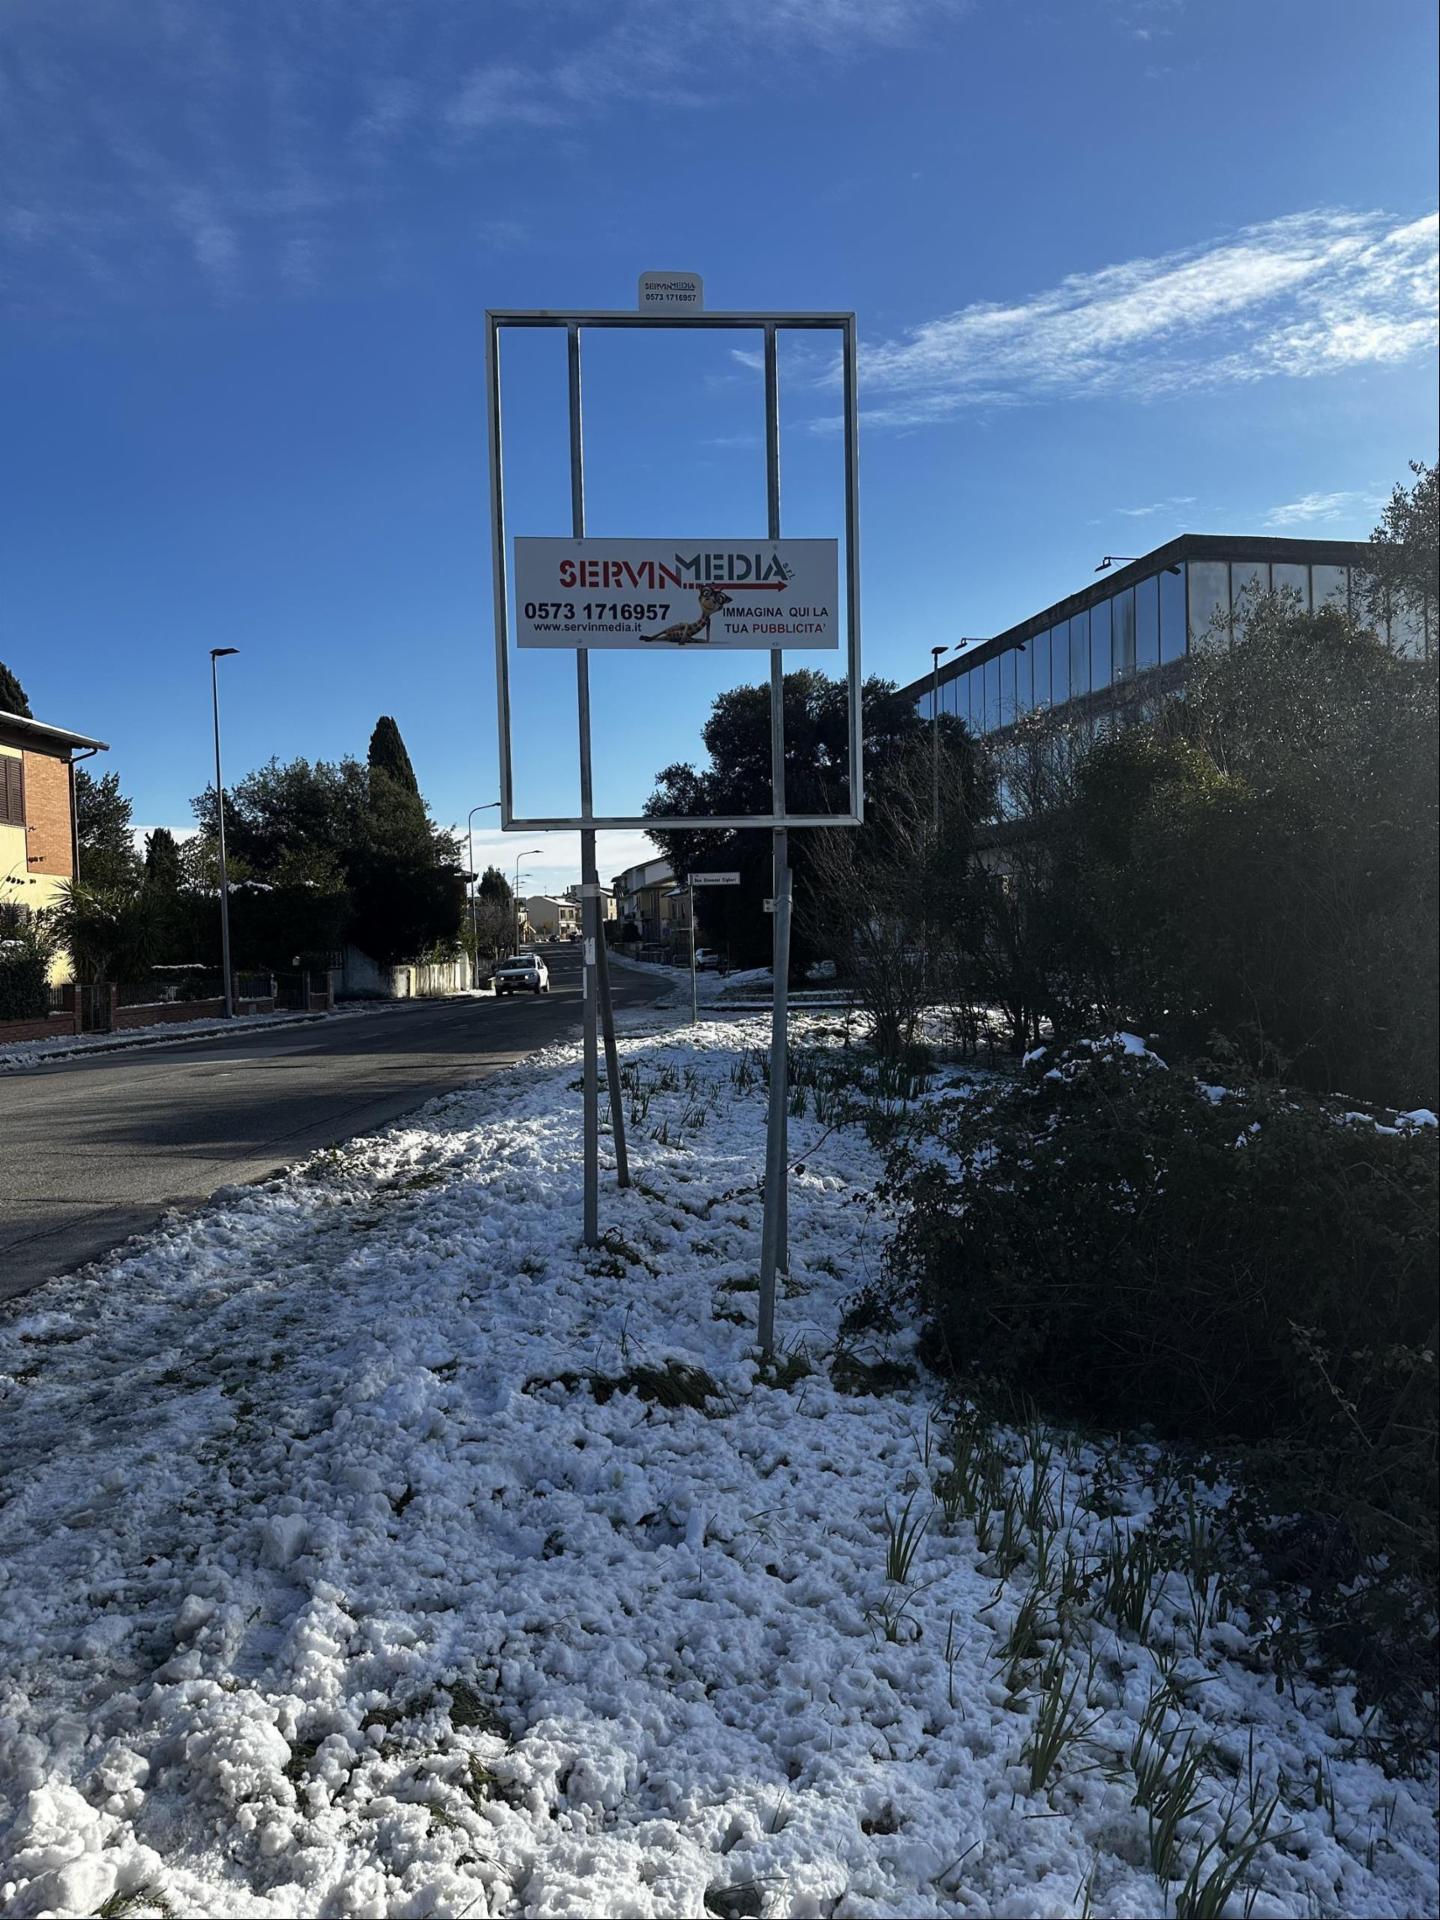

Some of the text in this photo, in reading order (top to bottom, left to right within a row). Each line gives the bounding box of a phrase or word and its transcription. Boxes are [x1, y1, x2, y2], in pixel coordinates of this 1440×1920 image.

[525, 602, 670, 620] 0573 1716957
[723, 607, 828, 617] IMMAGINA QUI LA
[534, 622, 642, 632] www.servinmedia.it
[725, 624, 748, 633] TUA
